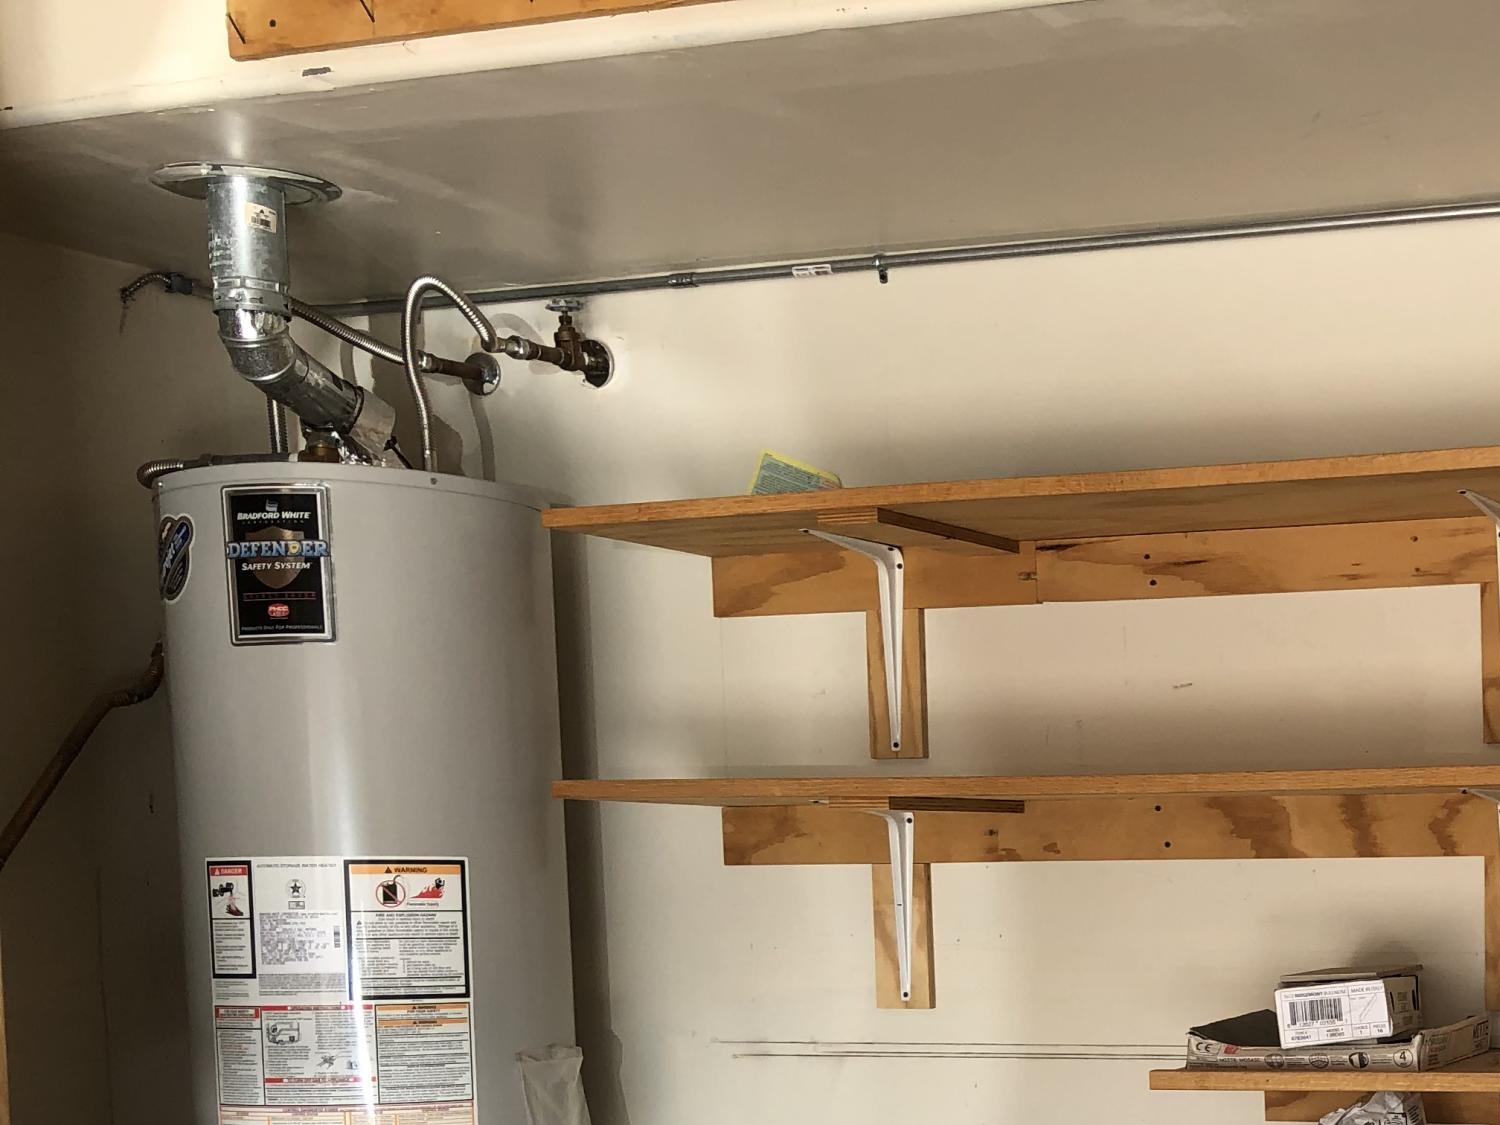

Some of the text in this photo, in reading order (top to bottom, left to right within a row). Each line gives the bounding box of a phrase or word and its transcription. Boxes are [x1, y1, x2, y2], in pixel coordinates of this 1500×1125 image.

[237, 511, 311, 520] BRADFORD WHITE
[227, 541, 329, 557] DEFENDER
[241, 562, 272, 571] SAFETY
[1399, 1051, 1407, 1061] 4
